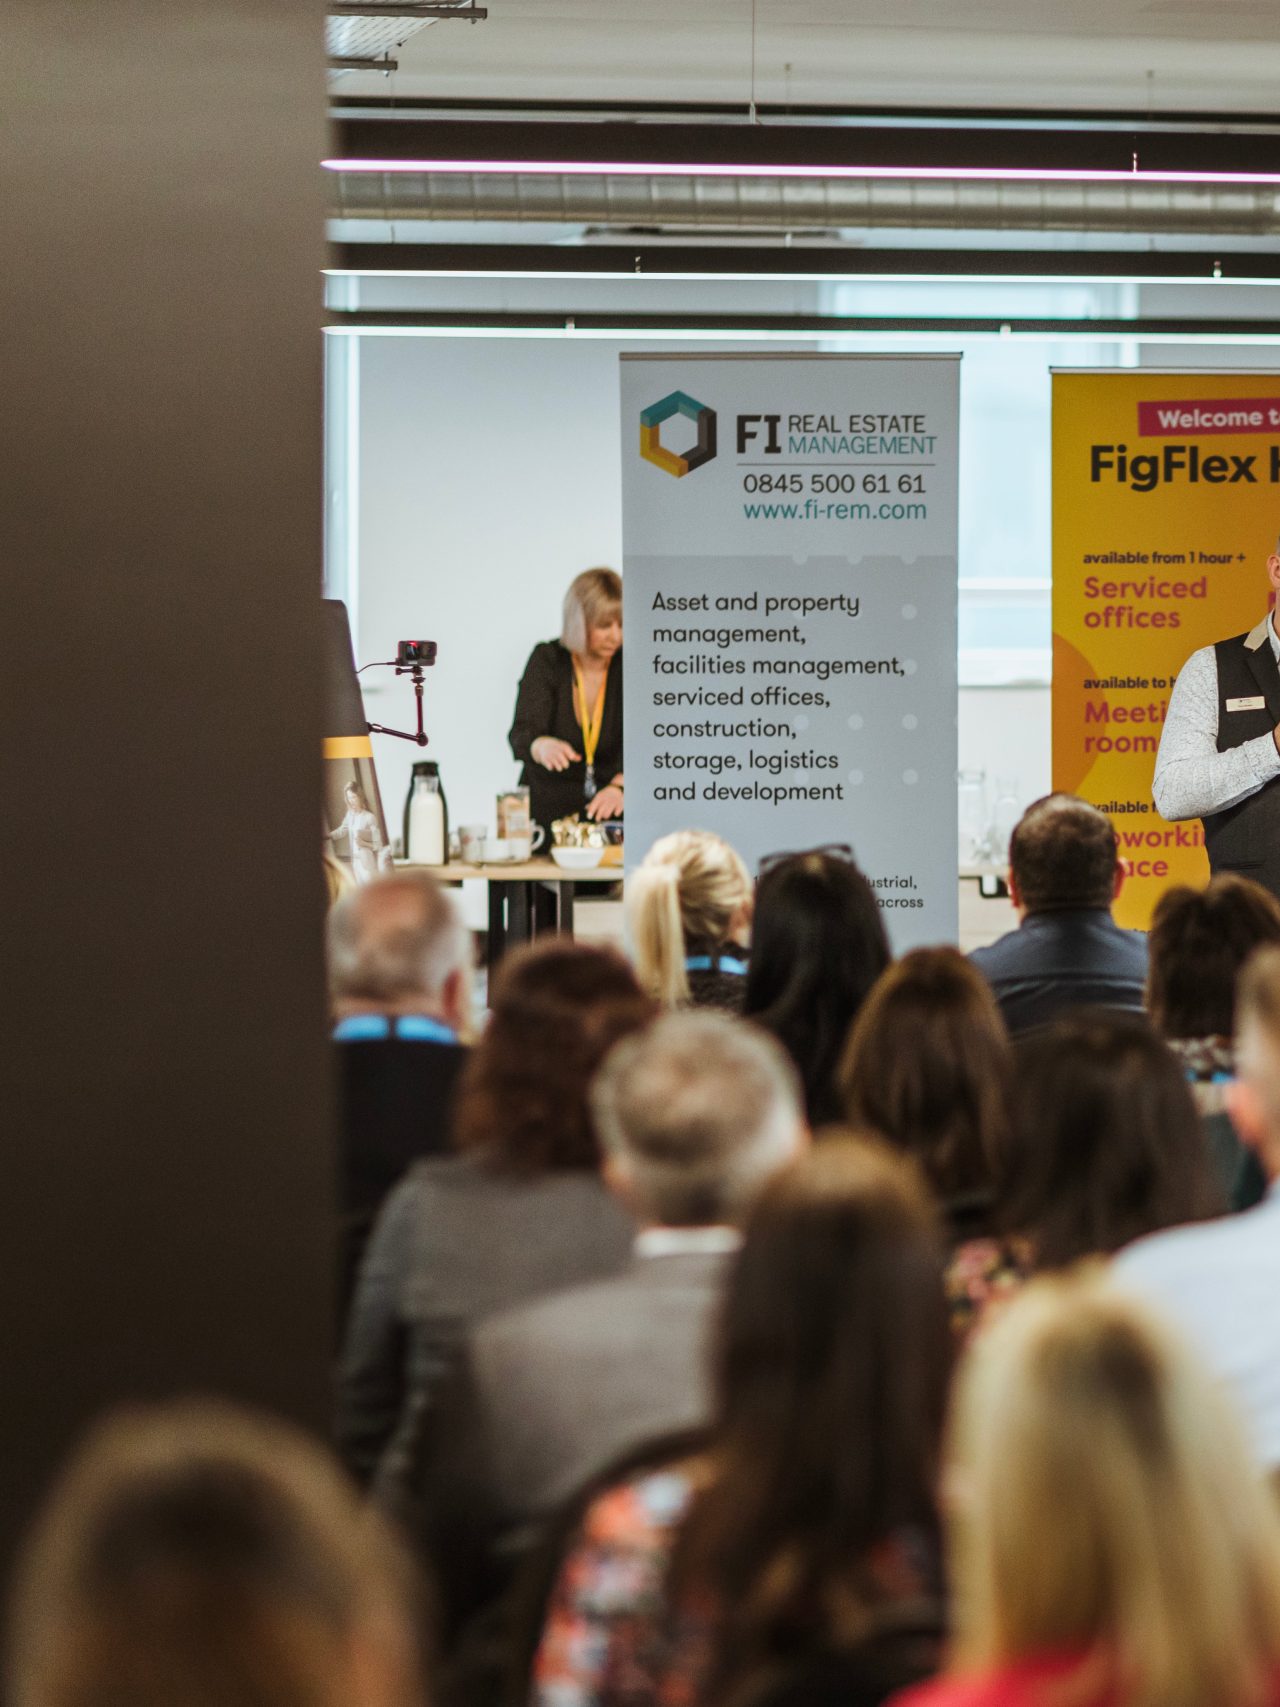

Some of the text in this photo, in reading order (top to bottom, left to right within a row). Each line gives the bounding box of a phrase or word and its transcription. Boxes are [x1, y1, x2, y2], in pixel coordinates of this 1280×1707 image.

[788, 415, 926, 433] REAL ESTATE
[1158, 408, 1263, 429] Welcome
[737, 415, 782, 454] FI
[788, 436, 937, 454] MANAGEMENT
[1090, 444, 1258, 493] FigFlex
[744, 474, 926, 494] 0845 500 61 61
[744, 499, 927, 520] www.fi-rem.com
[1083, 552, 1149, 564] available
[1152, 552, 1185, 564] from
[1198, 552, 1233, 564] hour
[1084, 576, 1207, 598] Serviced
[652, 592, 860, 617] Asset and property
[1084, 605, 1181, 628] offices
[653, 624, 806, 648] management,
[652, 655, 905, 680] facilities management,
[1084, 677, 1149, 689] available
[1152, 678, 1167, 689] to
[653, 687, 831, 708] serviced offices,
[1085, 701, 1166, 723] Meeti
[653, 718, 797, 739] construction,
[1085, 735, 1161, 753] room
[653, 750, 839, 775] storage, logistics
[654, 781, 844, 806] and development
[1094, 801, 1149, 813] vailable
[865, 876, 917, 889] ustrial,
[878, 898, 924, 909] across
